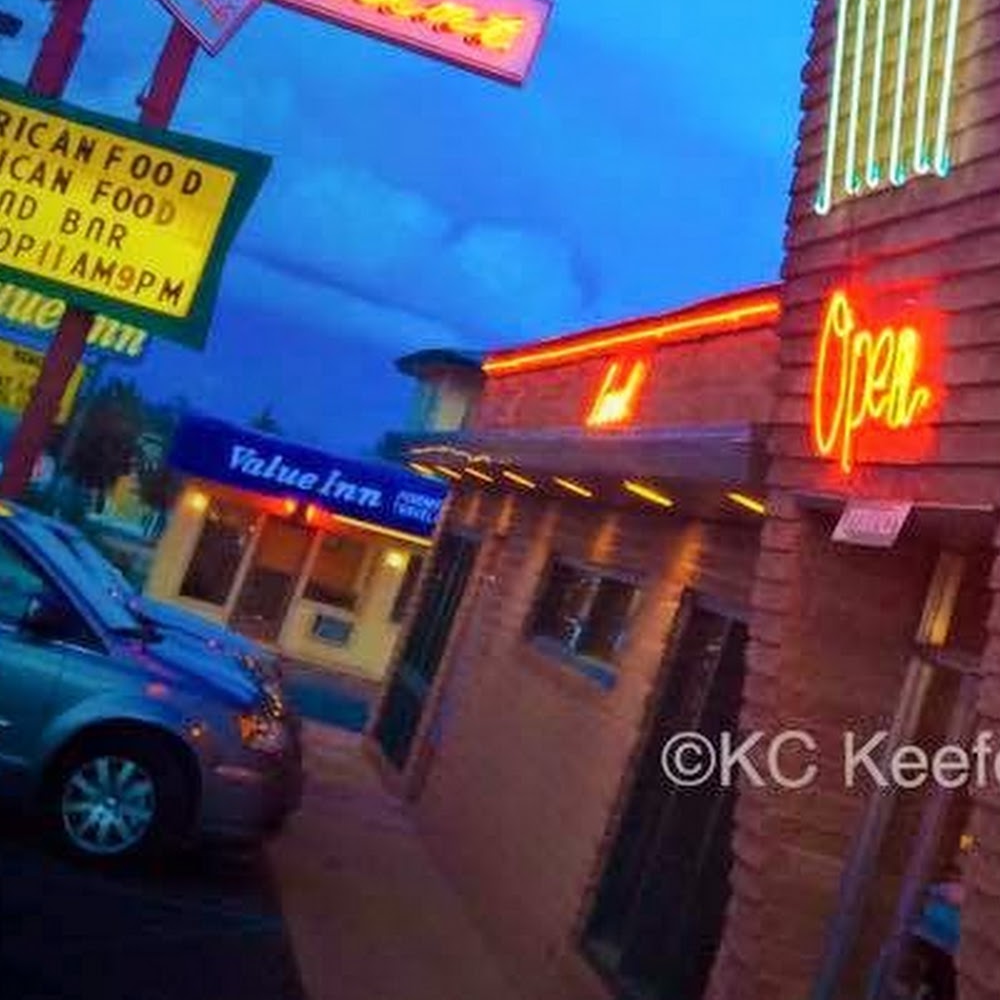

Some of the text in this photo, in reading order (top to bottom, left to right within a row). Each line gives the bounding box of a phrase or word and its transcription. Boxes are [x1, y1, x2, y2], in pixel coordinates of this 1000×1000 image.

[103, 144, 202, 196] FOOD
[91, 179, 176, 226] FOOD
[814, 290, 932, 475] Open
[228, 445, 318, 491] Value
[317, 470, 383, 508] Inn
